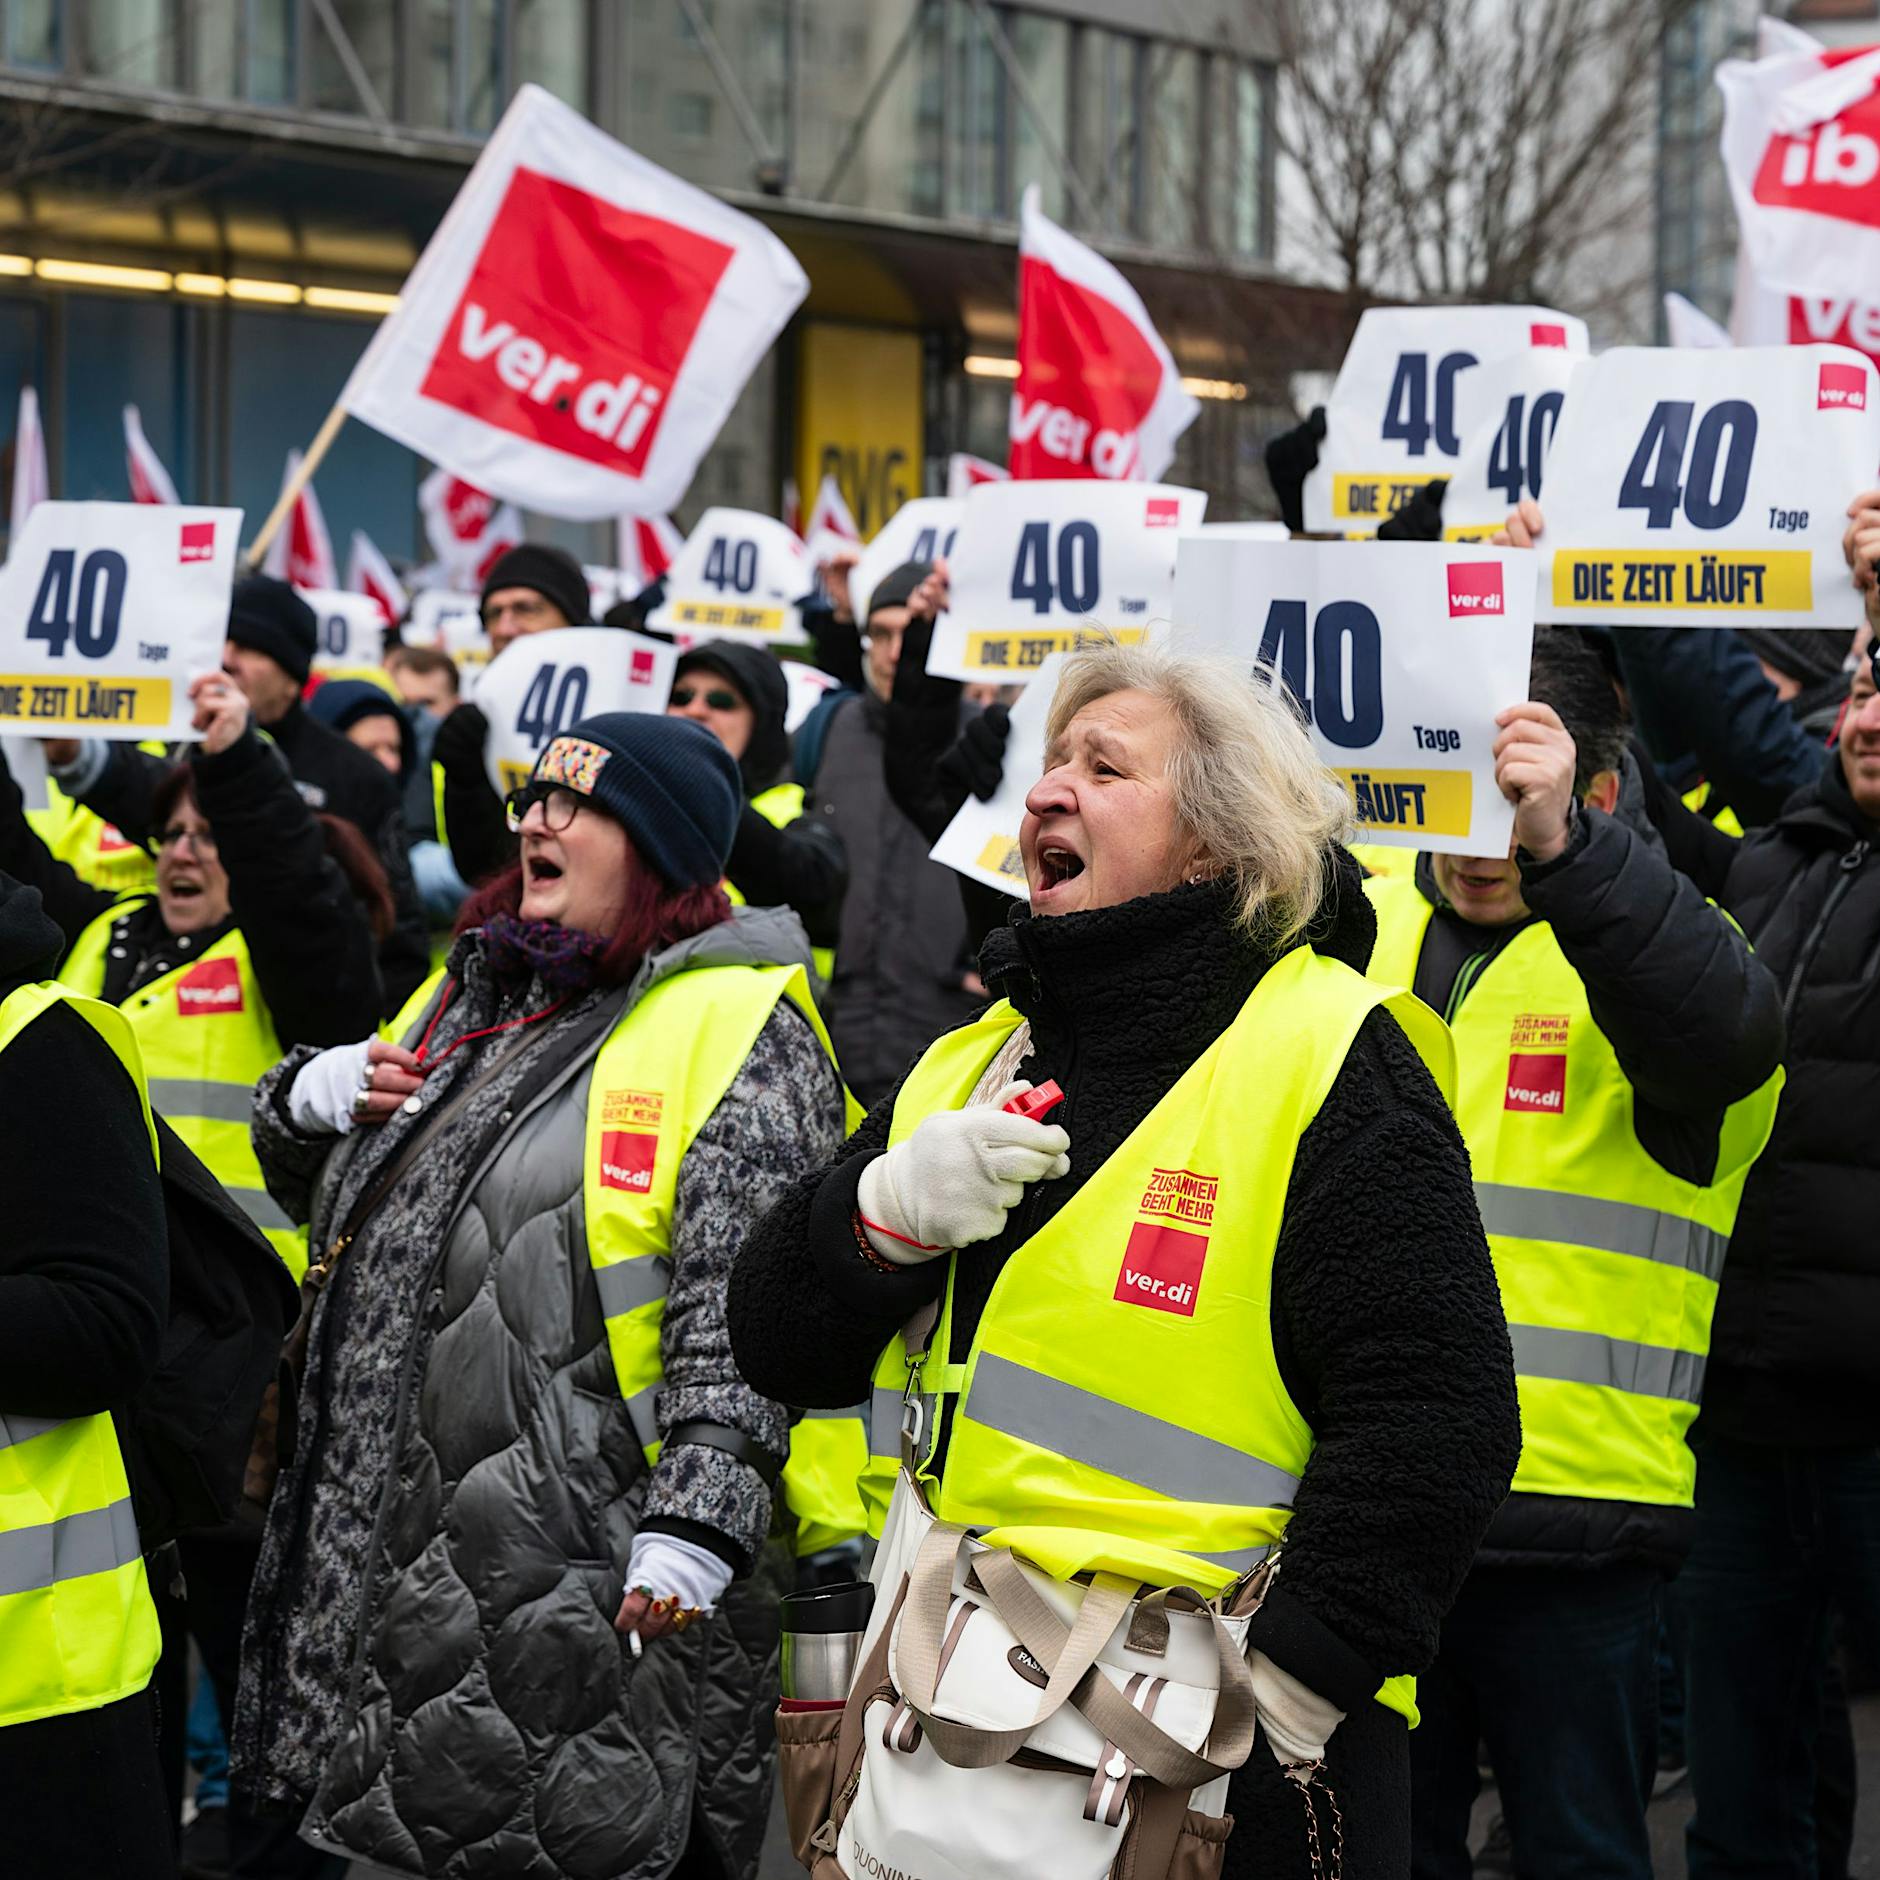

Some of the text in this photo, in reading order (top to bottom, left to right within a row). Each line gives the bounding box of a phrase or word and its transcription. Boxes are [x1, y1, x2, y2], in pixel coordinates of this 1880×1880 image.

[458, 302, 662, 453] ver.di
[1488, 391, 1565, 505] 40
[1617, 399, 1759, 531] 40
[1350, 484, 1379, 512] DIE
[1768, 507, 1810, 533] Tage
[703, 535, 758, 594] 40
[1010, 520, 1100, 614] 40
[1573, 555, 1767, 605] DIE ZEIT LÄUFT
[25, 548, 128, 660] 40
[981, 639, 1009, 666] DIE
[1252, 599, 1384, 750] 40
[30, 686, 68, 717] ZEIT
[76, 680, 137, 720] LÄUFT
[516, 663, 589, 749] 40
[1412, 724, 1461, 752] Tage
[1350, 773, 1426, 826] ÄUFT
[1513, 1018, 1569, 1029] ZUSAMMEN
[1540, 1031, 1568, 1042] MEHR
[1507, 1086, 1561, 1107] ver.di
[602, 1163, 651, 1187] ver.di
[1147, 1173, 1218, 1201] ZUSAMMEN
[1141, 1191, 1214, 1220] GEHT MEHR
[1125, 1268, 1193, 1305] ver.di
